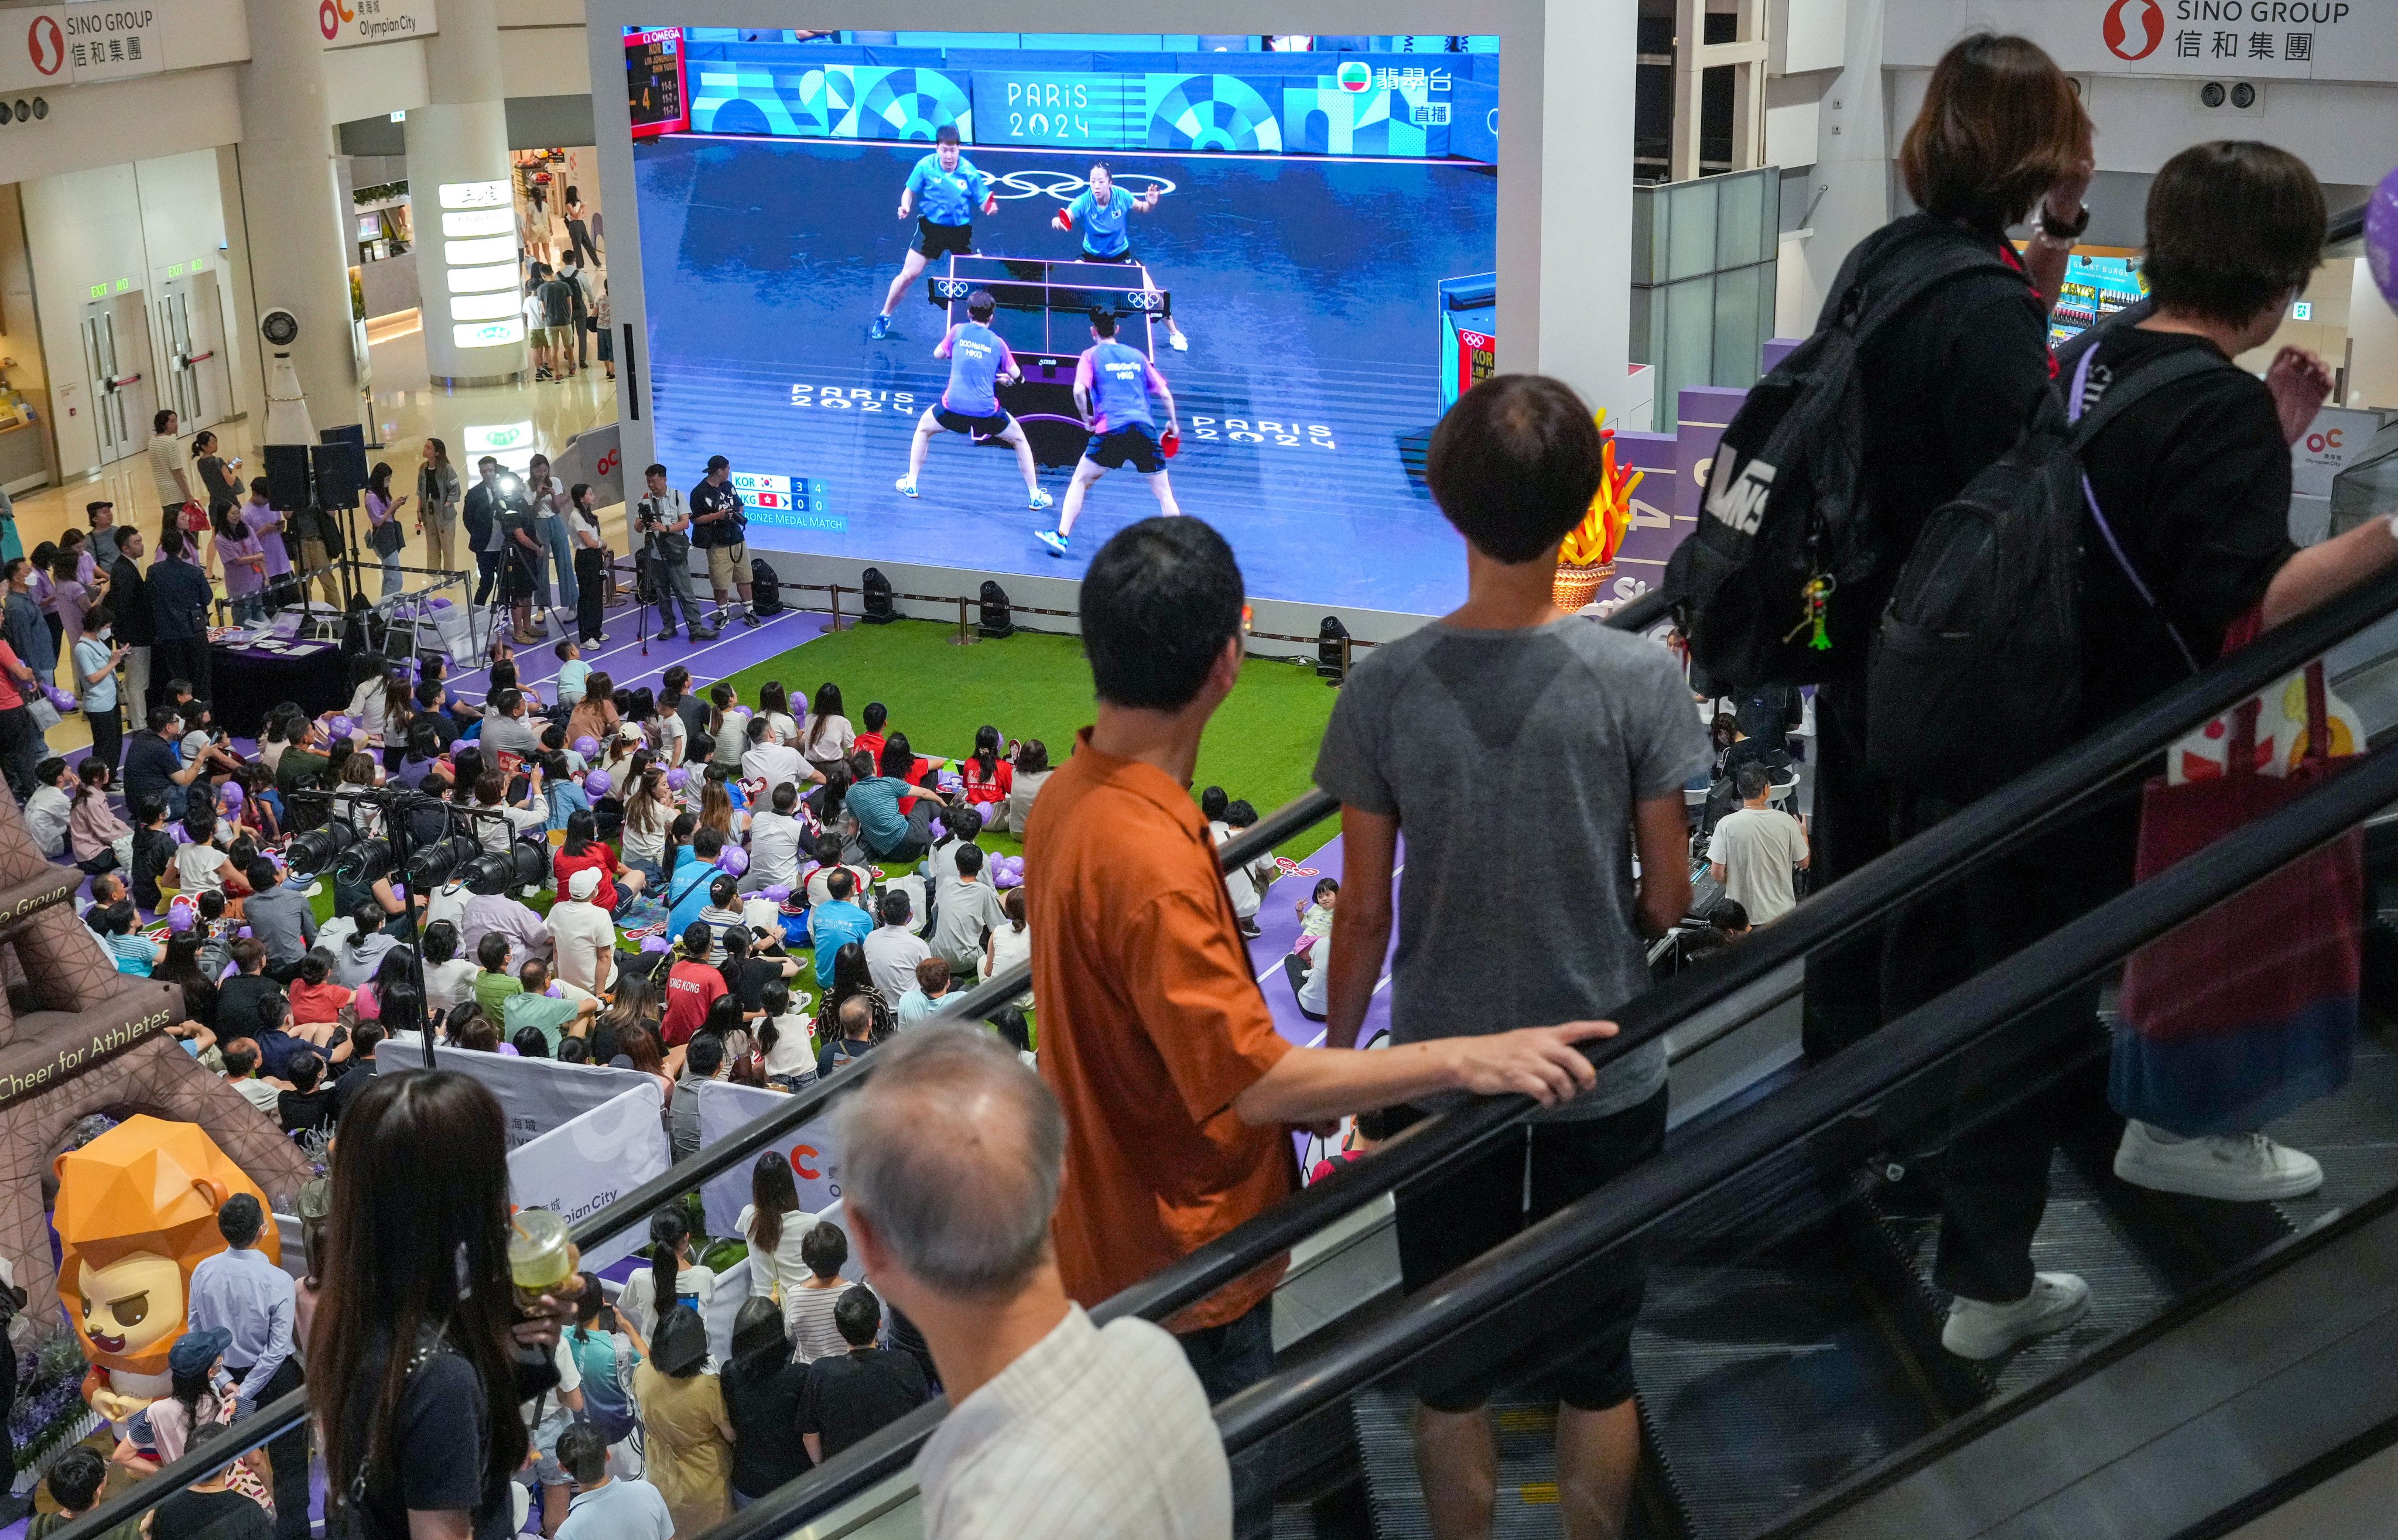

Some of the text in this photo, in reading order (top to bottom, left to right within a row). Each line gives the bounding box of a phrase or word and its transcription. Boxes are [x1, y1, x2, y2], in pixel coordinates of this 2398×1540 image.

[2177, 0, 2349, 23] SINO GROUP
[67, 11, 153, 35] SINO GROUP
[360, 15, 416, 38] Olympian City
[651, 29, 680, 43] OMEGA
[2175, 29, 2313, 61] 信和集團
[71, 36, 142, 67] 信和集團
[1376, 67, 1452, 91] 翡翠台
[1414, 105, 1447, 122] 直播
[1010, 112, 1089, 138] 2024
[169, 263, 183, 278] EXIT
[91, 283, 108, 298] EXIT
[966, 348, 983, 359] HKG
[1472, 348, 1493, 367] KOR
[791, 395, 914, 415] 2024
[1195, 429, 1335, 450] 2024
[2306, 429, 2344, 453] OC
[597, 449, 618, 475] OC
[735, 477, 755, 488] KOR
[797, 481, 803, 492] 3
[815, 484, 821, 493] 4
[798, 499, 804, 509] 0
[816, 501, 823, 511] 0
[744, 512, 773, 523] RONZE
[1628, 498, 1671, 531] 4
[16, 885, 67, 916] Group
[681, 980, 700, 994] KONG
[0, 1008, 170, 1100] Cheer for Athletes
[511, 1117, 538, 1132] 海城
[591, 1189, 618, 1209] City
